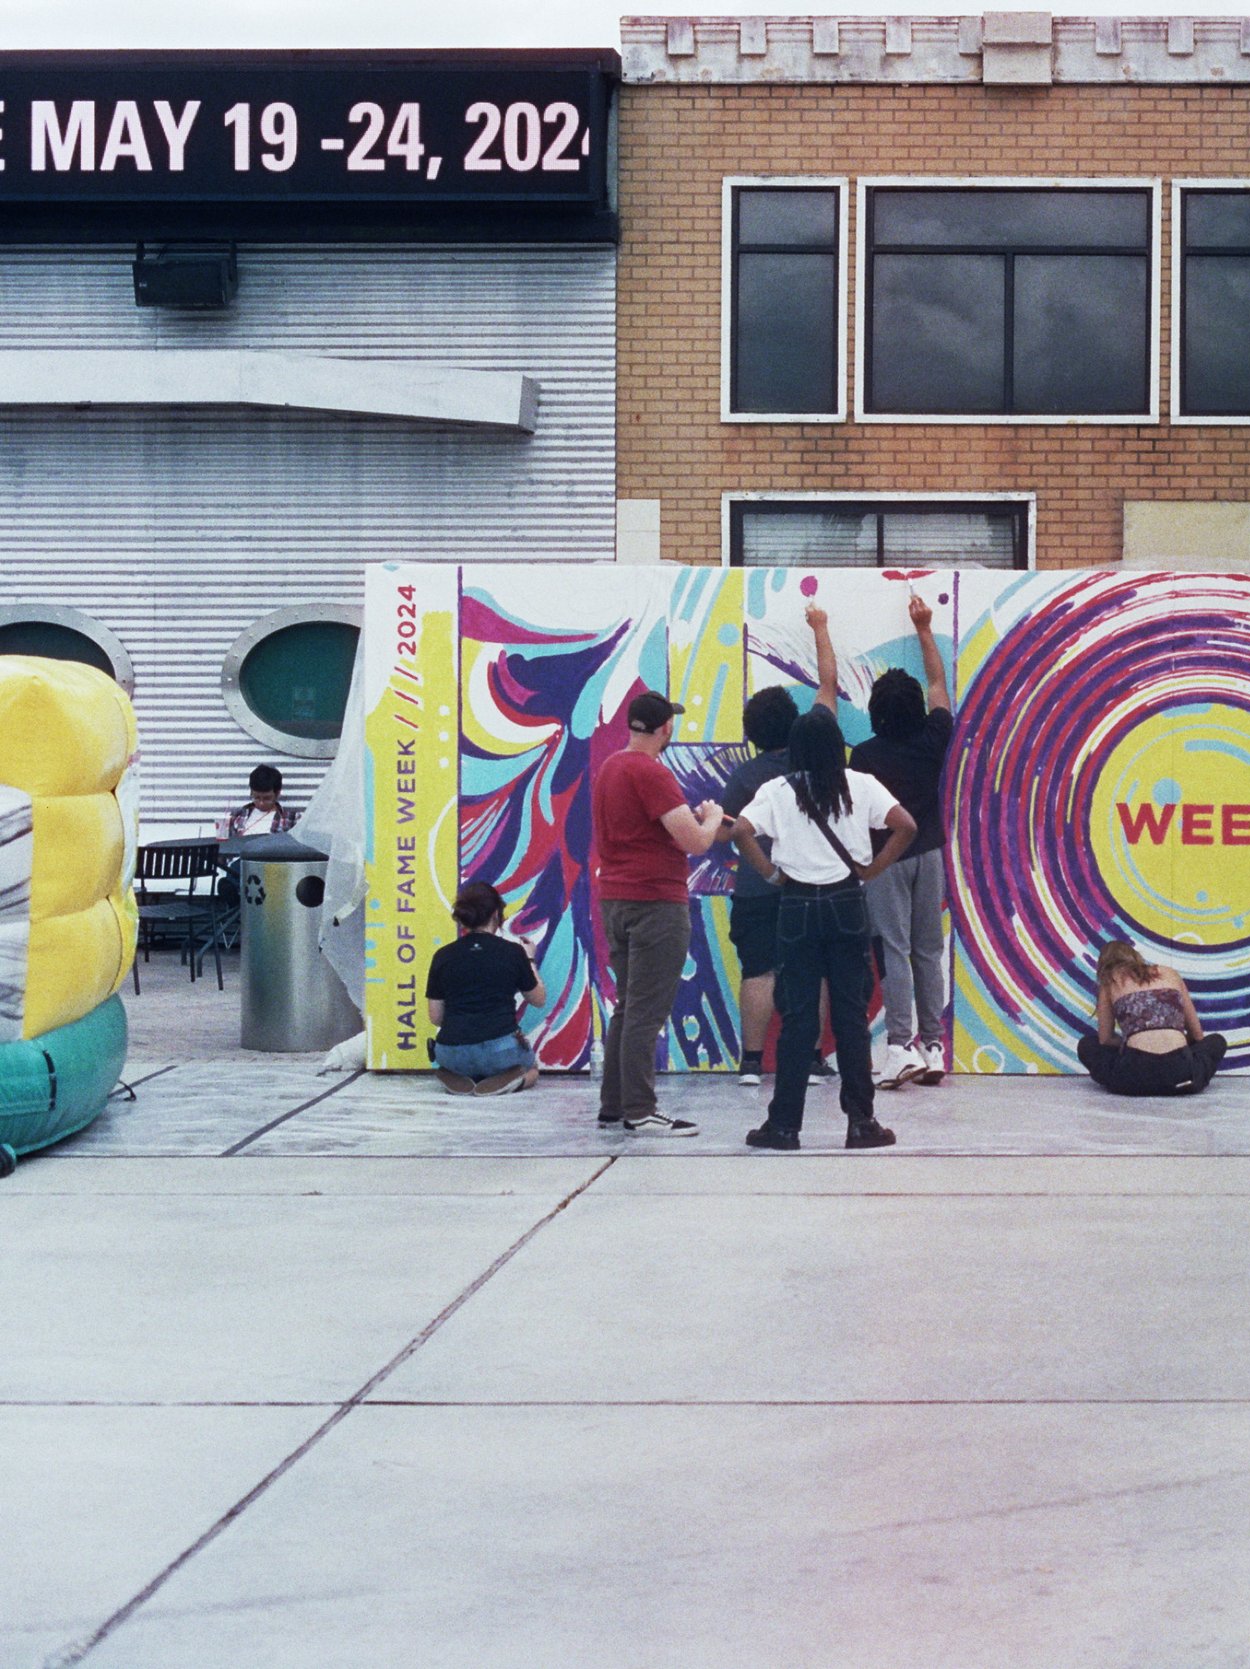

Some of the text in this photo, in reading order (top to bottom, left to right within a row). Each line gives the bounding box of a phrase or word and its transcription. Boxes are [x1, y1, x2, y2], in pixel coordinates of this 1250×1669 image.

[31, 100, 202, 171] MAY
[224, 102, 298, 172] 19
[464, 101, 590, 172] 202
[396, 739, 416, 825] WEEK
[396, 836, 416, 913] FAME
[396, 925, 416, 964] OF
[396, 974, 417, 1051] HALL
